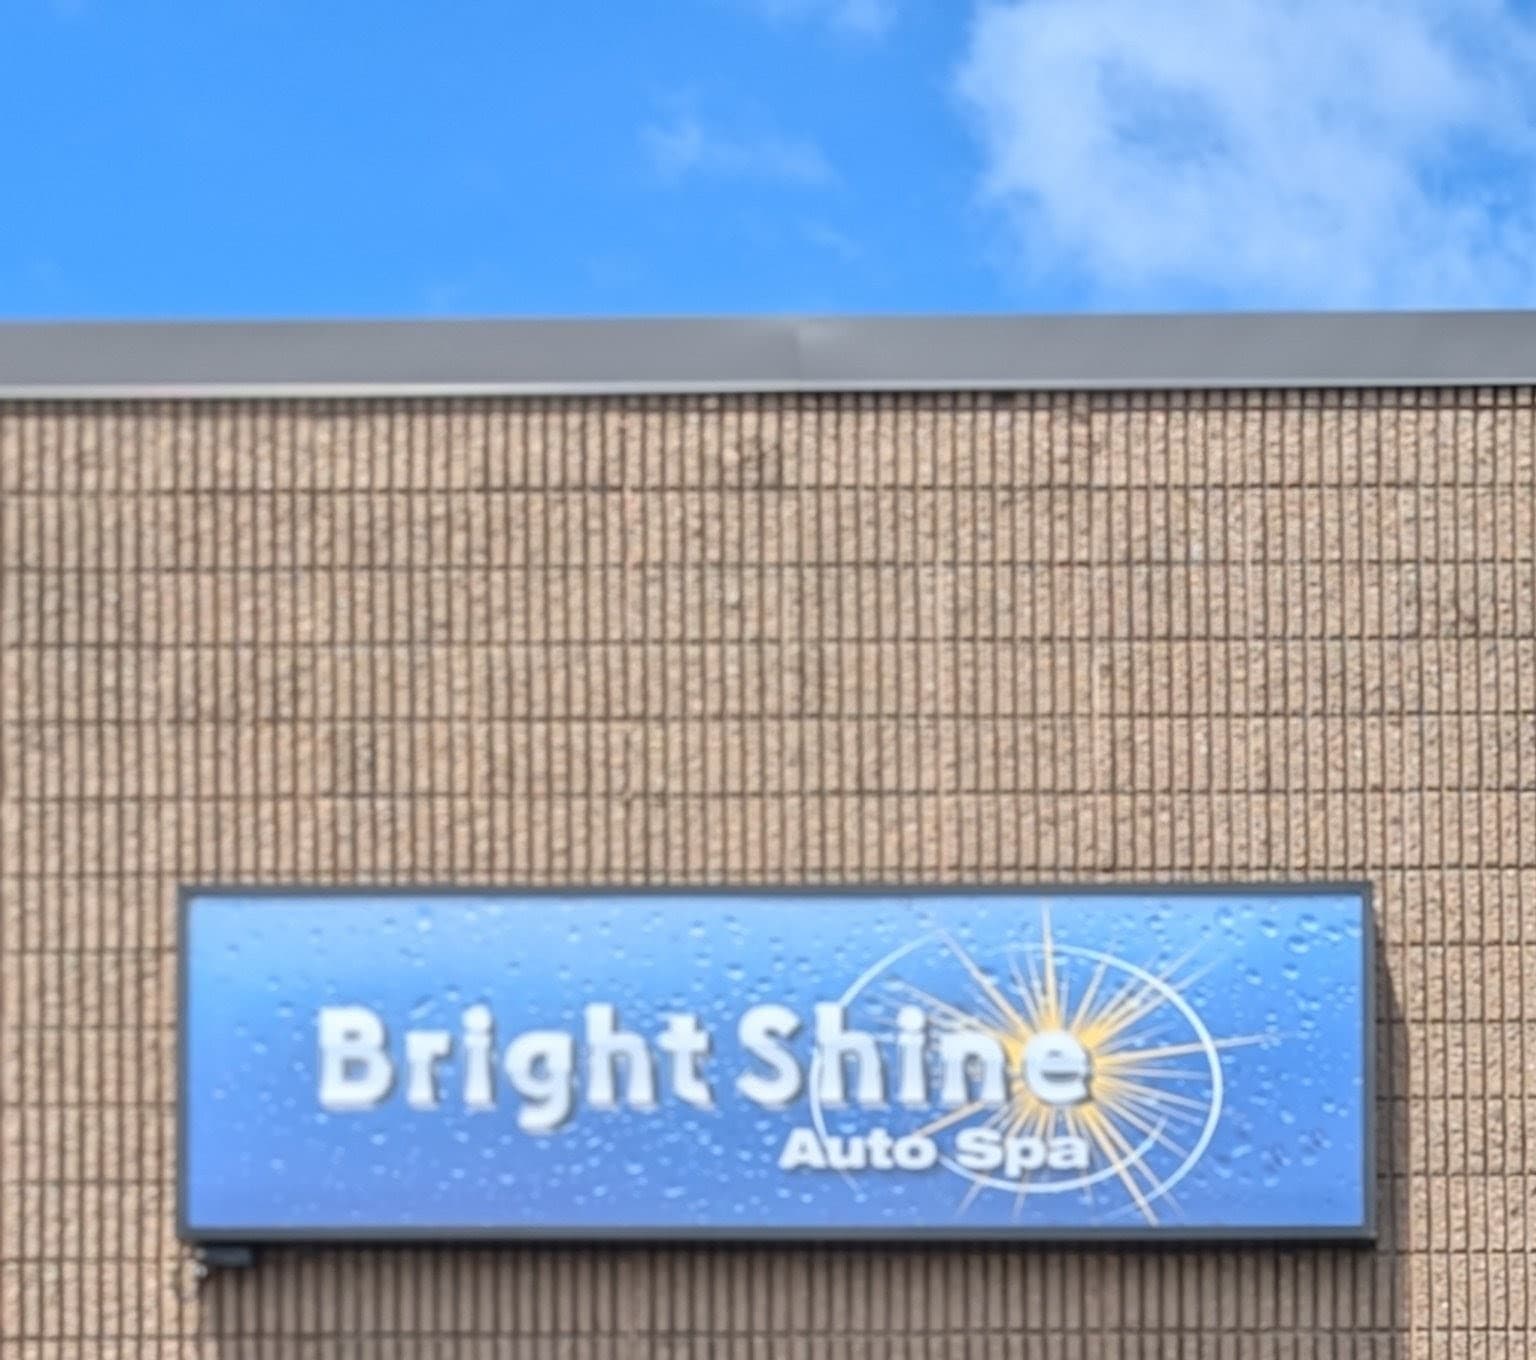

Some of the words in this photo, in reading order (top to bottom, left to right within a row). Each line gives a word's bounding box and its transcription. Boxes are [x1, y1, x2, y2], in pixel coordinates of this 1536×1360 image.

[318, 1002, 716, 1135] Bright
[735, 1002, 1089, 1111] Shine
[777, 1126, 940, 1172] Auto
[954, 1126, 1091, 1178] Spa
